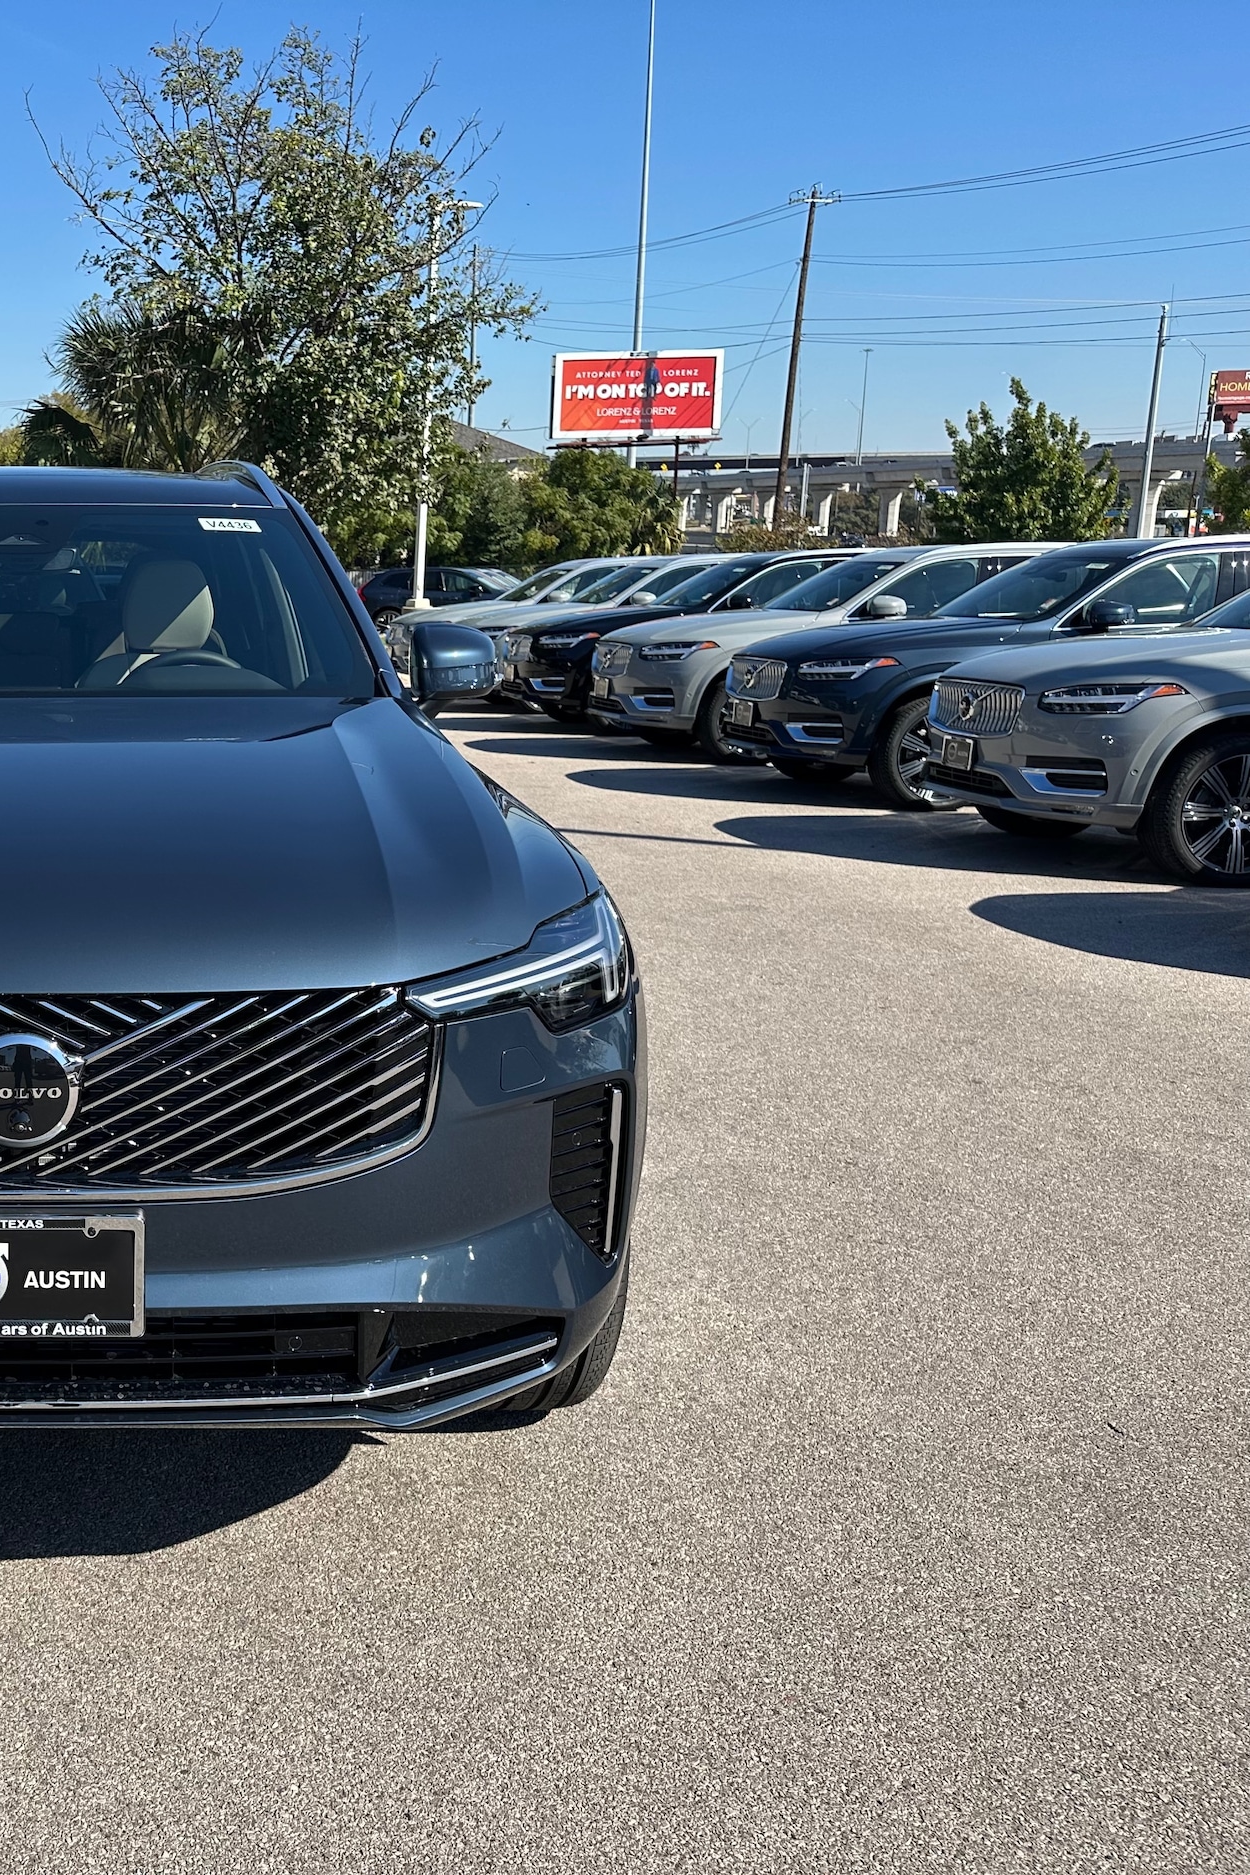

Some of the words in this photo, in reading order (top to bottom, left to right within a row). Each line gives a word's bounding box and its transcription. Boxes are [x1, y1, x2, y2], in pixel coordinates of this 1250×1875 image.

[565, 384, 595, 399] I'M
[596, 384, 626, 399] ON
[664, 382, 690, 397] OF
[691, 382, 710, 397] IT.
[596, 408, 632, 416] LORENZ
[633, 407, 640, 415] &
[642, 406, 677, 416] LORENZ
[206, 521, 252, 529] V4436
[0, 1219, 44, 1229] TEXAS
[23, 1270, 106, 1289] AUSTIN
[31, 1322, 48, 1336] of
[52, 1322, 106, 1336] Austin
